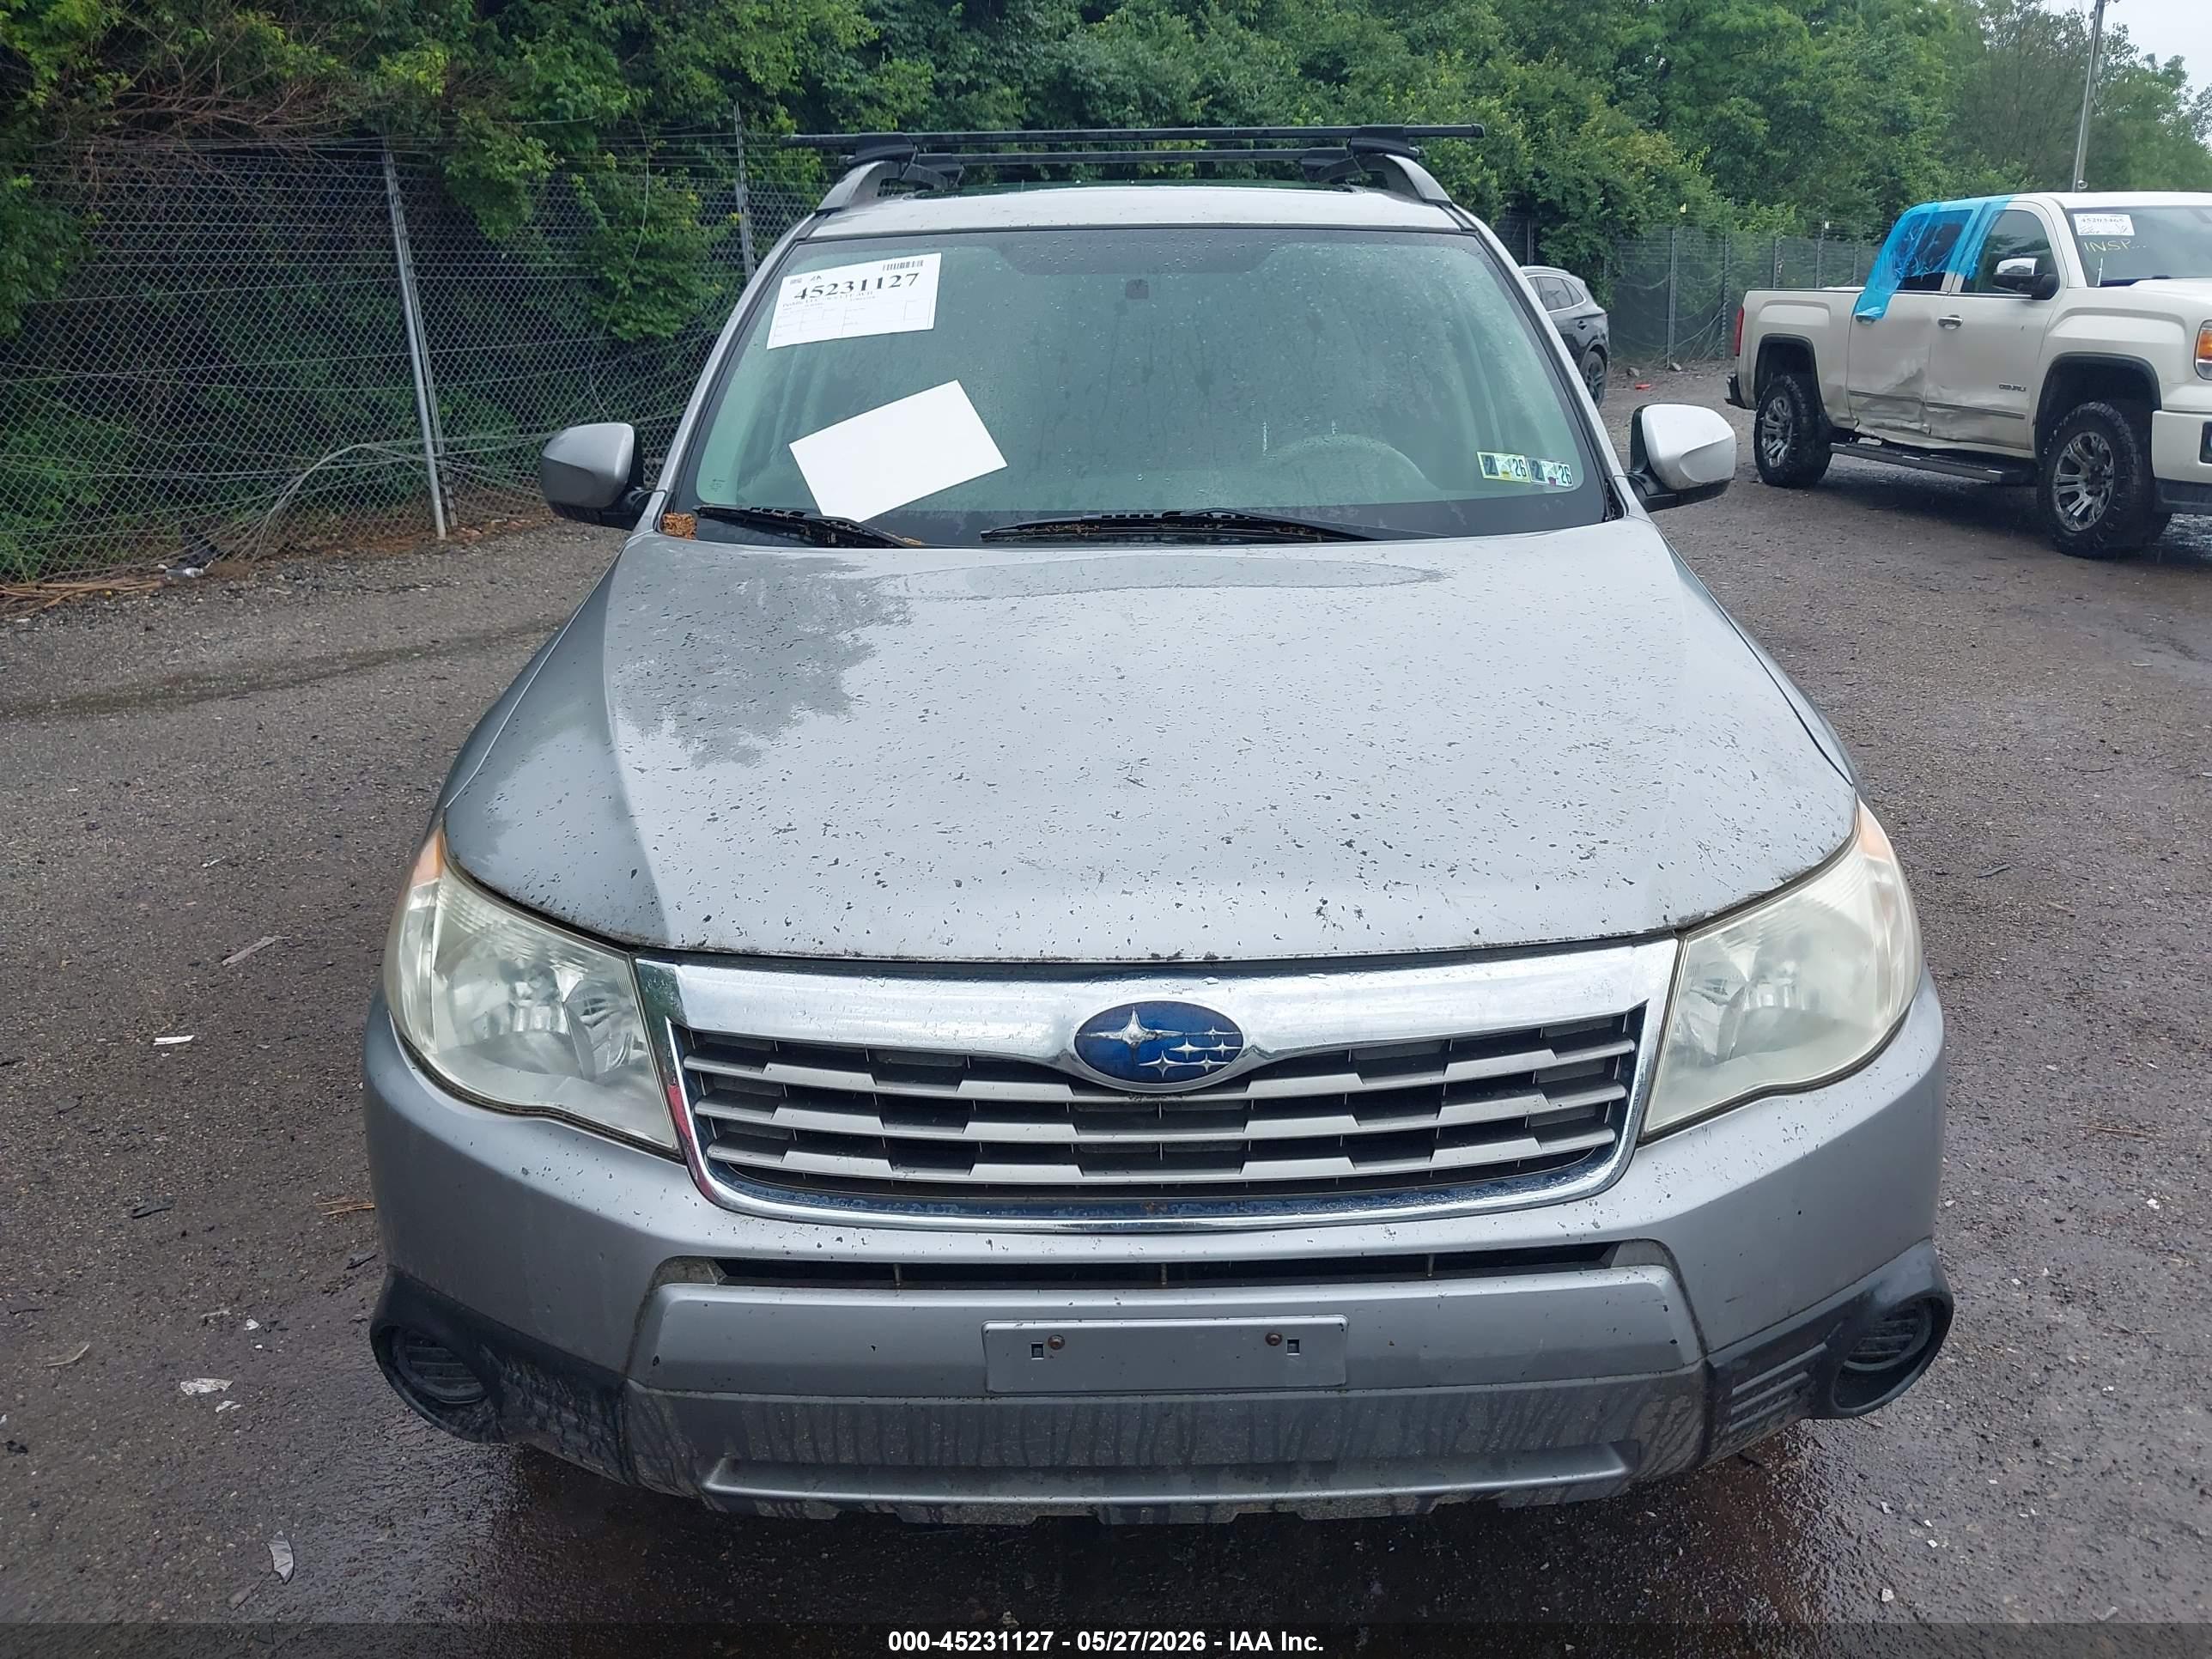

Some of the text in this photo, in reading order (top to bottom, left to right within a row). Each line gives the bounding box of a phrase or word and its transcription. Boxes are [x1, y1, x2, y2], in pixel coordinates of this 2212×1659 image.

[794, 272, 919, 300] 45231127
[1512, 458, 1528, 477] 26
[1558, 465, 1572, 484] 26
